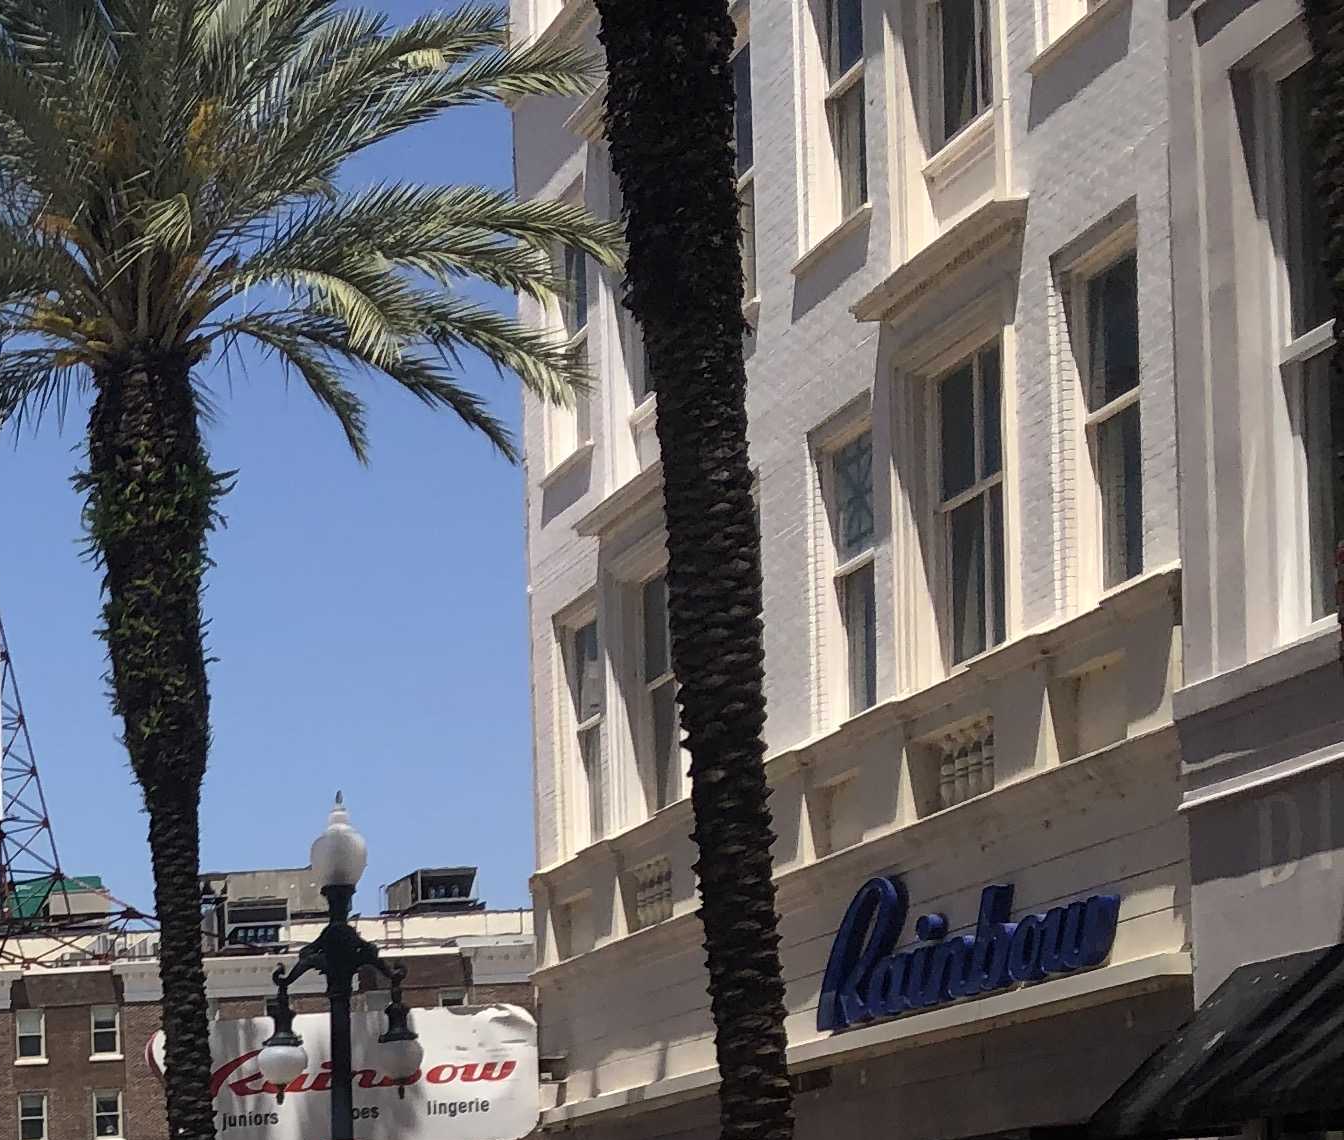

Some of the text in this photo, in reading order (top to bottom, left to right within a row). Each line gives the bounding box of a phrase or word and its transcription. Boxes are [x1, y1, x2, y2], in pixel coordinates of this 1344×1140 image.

[816, 876, 1121, 1032] Rainbow
[352, 1107, 380, 1122] oes
[426, 1097, 490, 1118] lingerie
[222, 1110, 279, 1131] juniors
